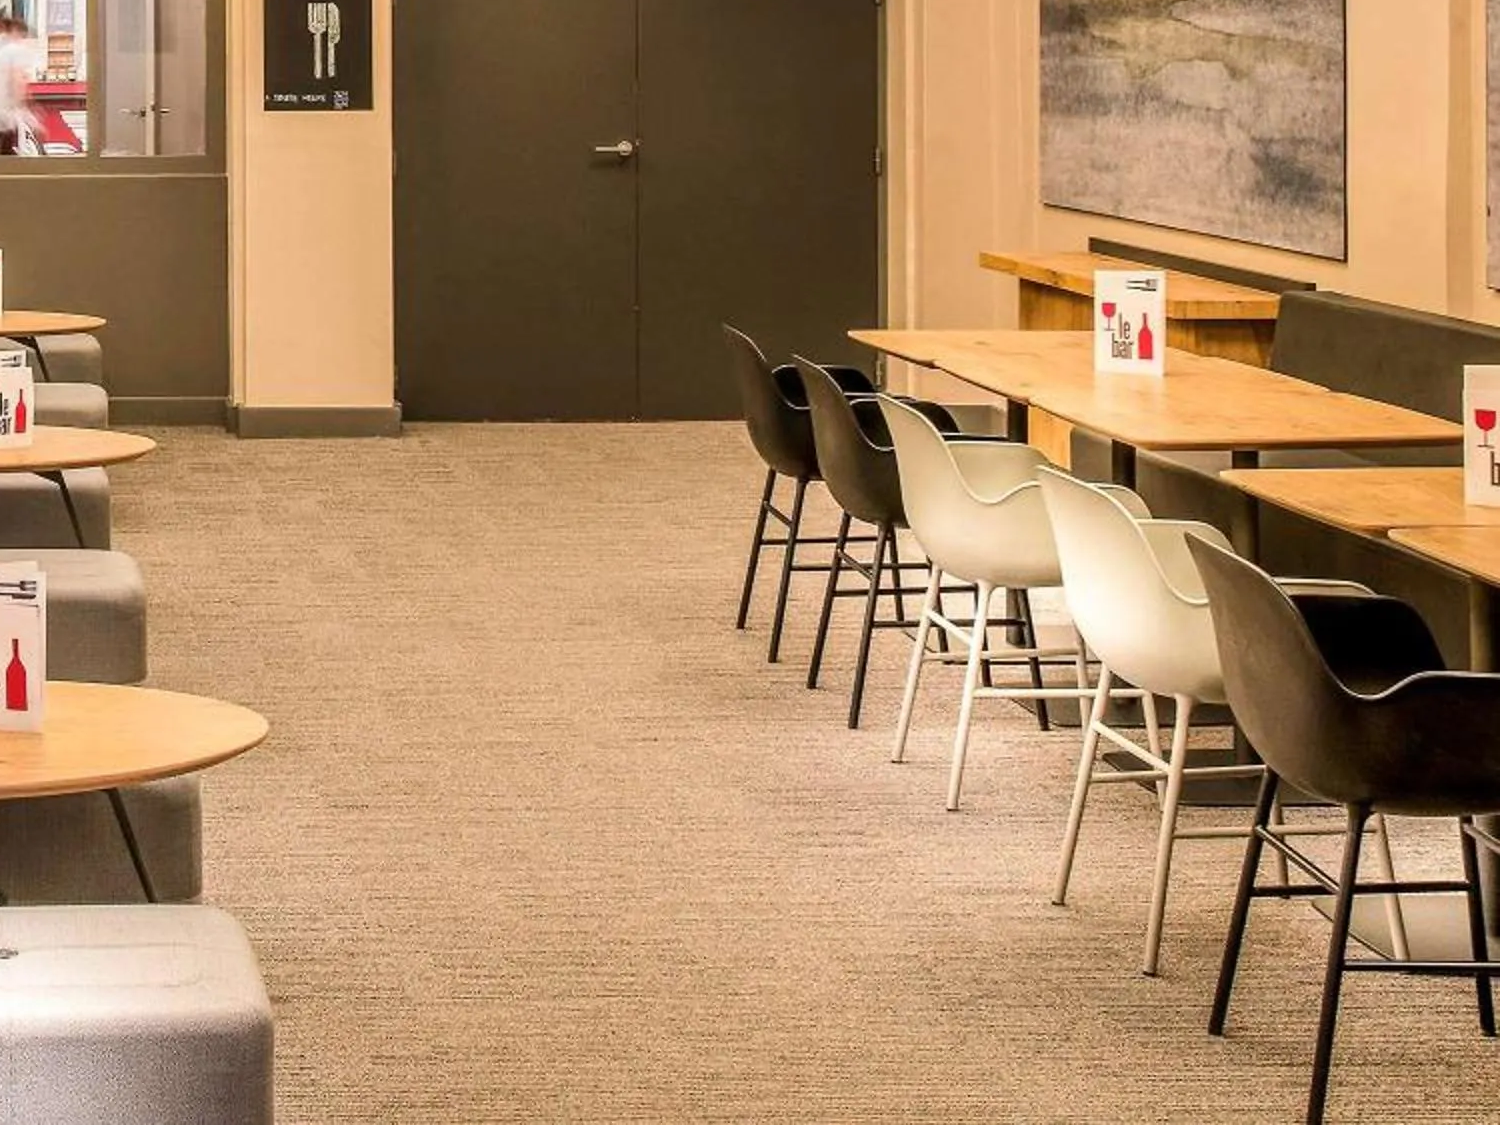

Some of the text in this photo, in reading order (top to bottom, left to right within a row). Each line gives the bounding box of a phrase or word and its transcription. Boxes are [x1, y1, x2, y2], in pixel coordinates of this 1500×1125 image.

[1118, 312, 1131, 340] le
[1111, 333, 1134, 359] bar
[0, 392, 9, 416] le
